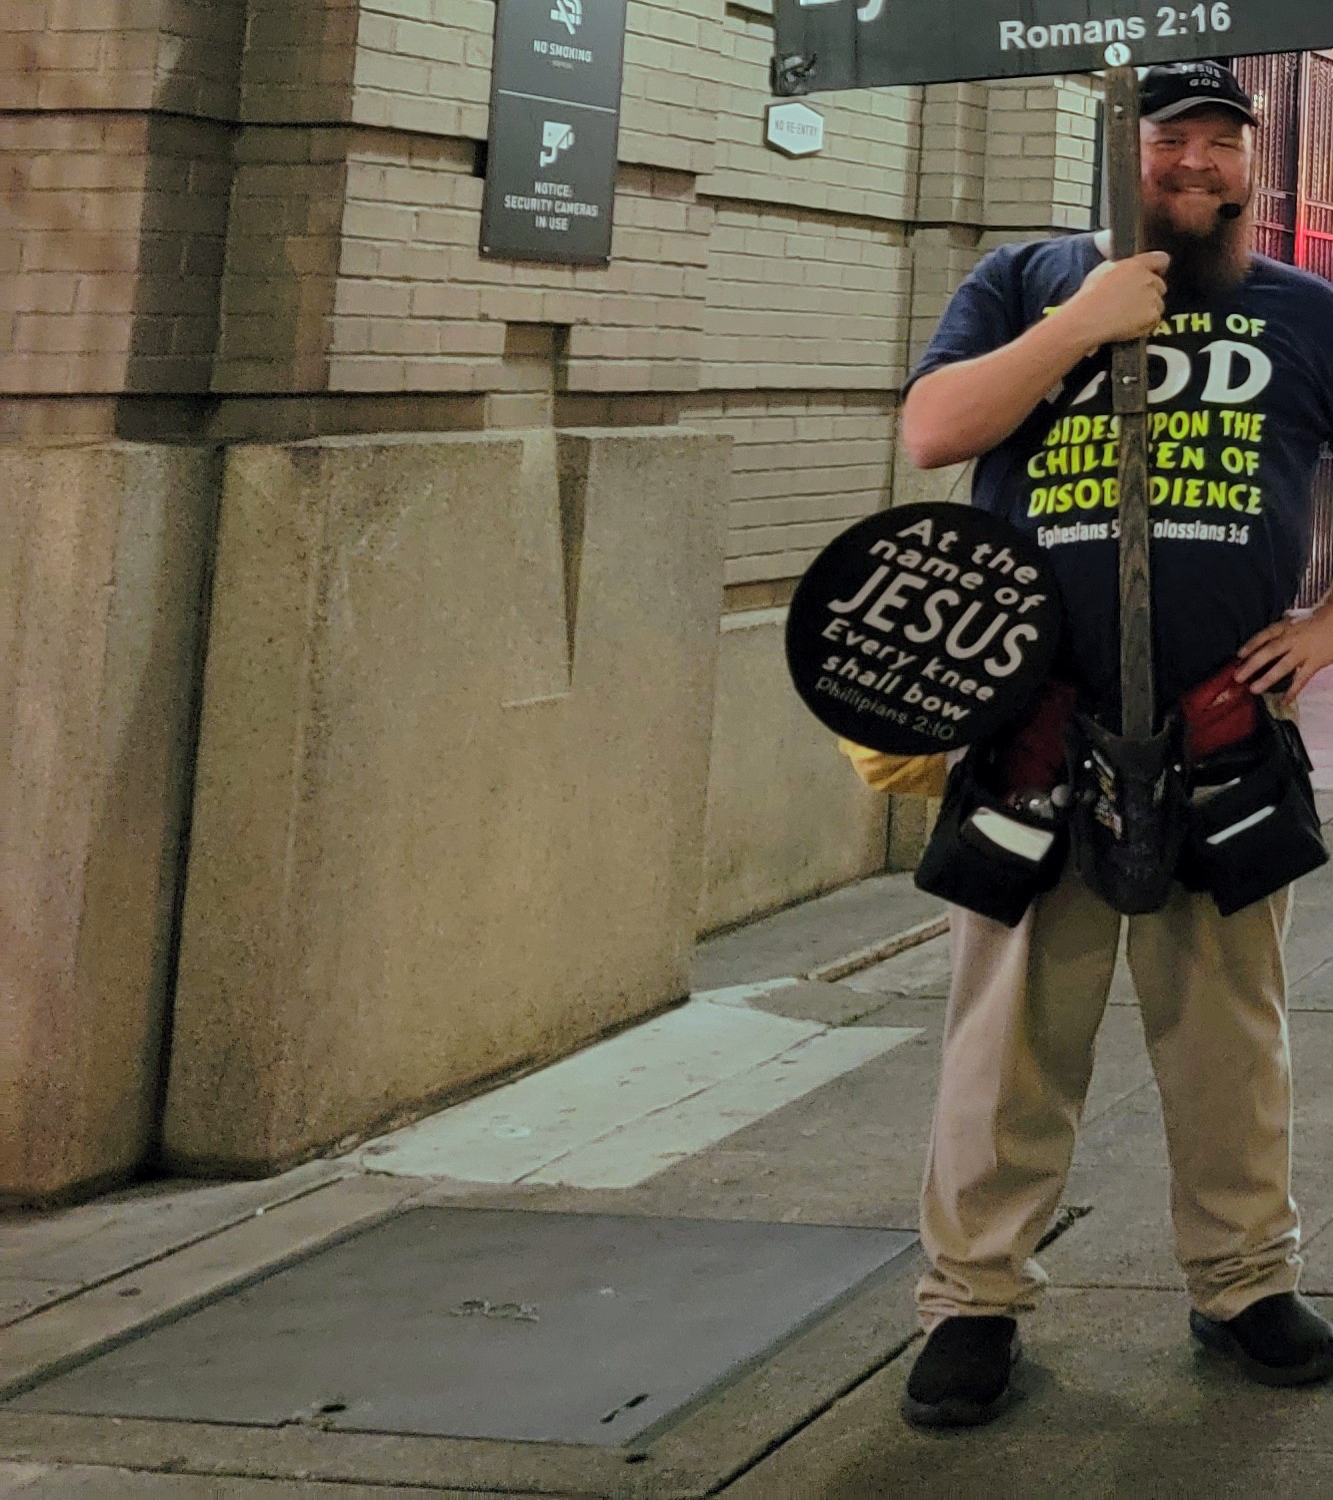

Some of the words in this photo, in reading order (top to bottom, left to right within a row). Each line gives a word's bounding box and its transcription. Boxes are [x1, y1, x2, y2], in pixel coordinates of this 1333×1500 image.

[999, 12, 1145, 52] Romans
[1157, 2, 1232, 38] 2:16
[534, 40, 547, 53] NO
[549, 43, 592, 62] SMOKING
[774, 120, 784, 132] NO
[786, 121, 818, 136] RE-ENTRY
[504, 194, 552, 211] SECURITY
[555, 200, 598, 217] CAMERAS
[535, 215, 547, 228] IN
[549, 218, 568, 231] USE
[1153, 312, 1211, 337] ATH
[1225, 313, 1266, 337] OF
[1043, 415, 1120, 446] BIDES
[1149, 410, 1209, 438] PON
[1220, 410, 1265, 443] THE
[1027, 441, 1204, 478] CHILDEN
[1221, 446, 1259, 476] OF
[1027, 476, 1262, 518] DISOBDIENCE
[896, 518, 959, 552] At
[972, 543, 1038, 584] the
[1038, 520, 1107, 549] Ephesians
[1149, 518, 1225, 542] olossians
[1228, 524, 1249, 545] 3:6
[870, 538, 984, 590] name
[994, 586, 1046, 614] of
[827, 566, 1039, 678] JESUS
[821, 618, 919, 670] Every
[920, 656, 995, 702] knee
[822, 654, 903, 694] shall
[903, 683, 970, 721] bow
